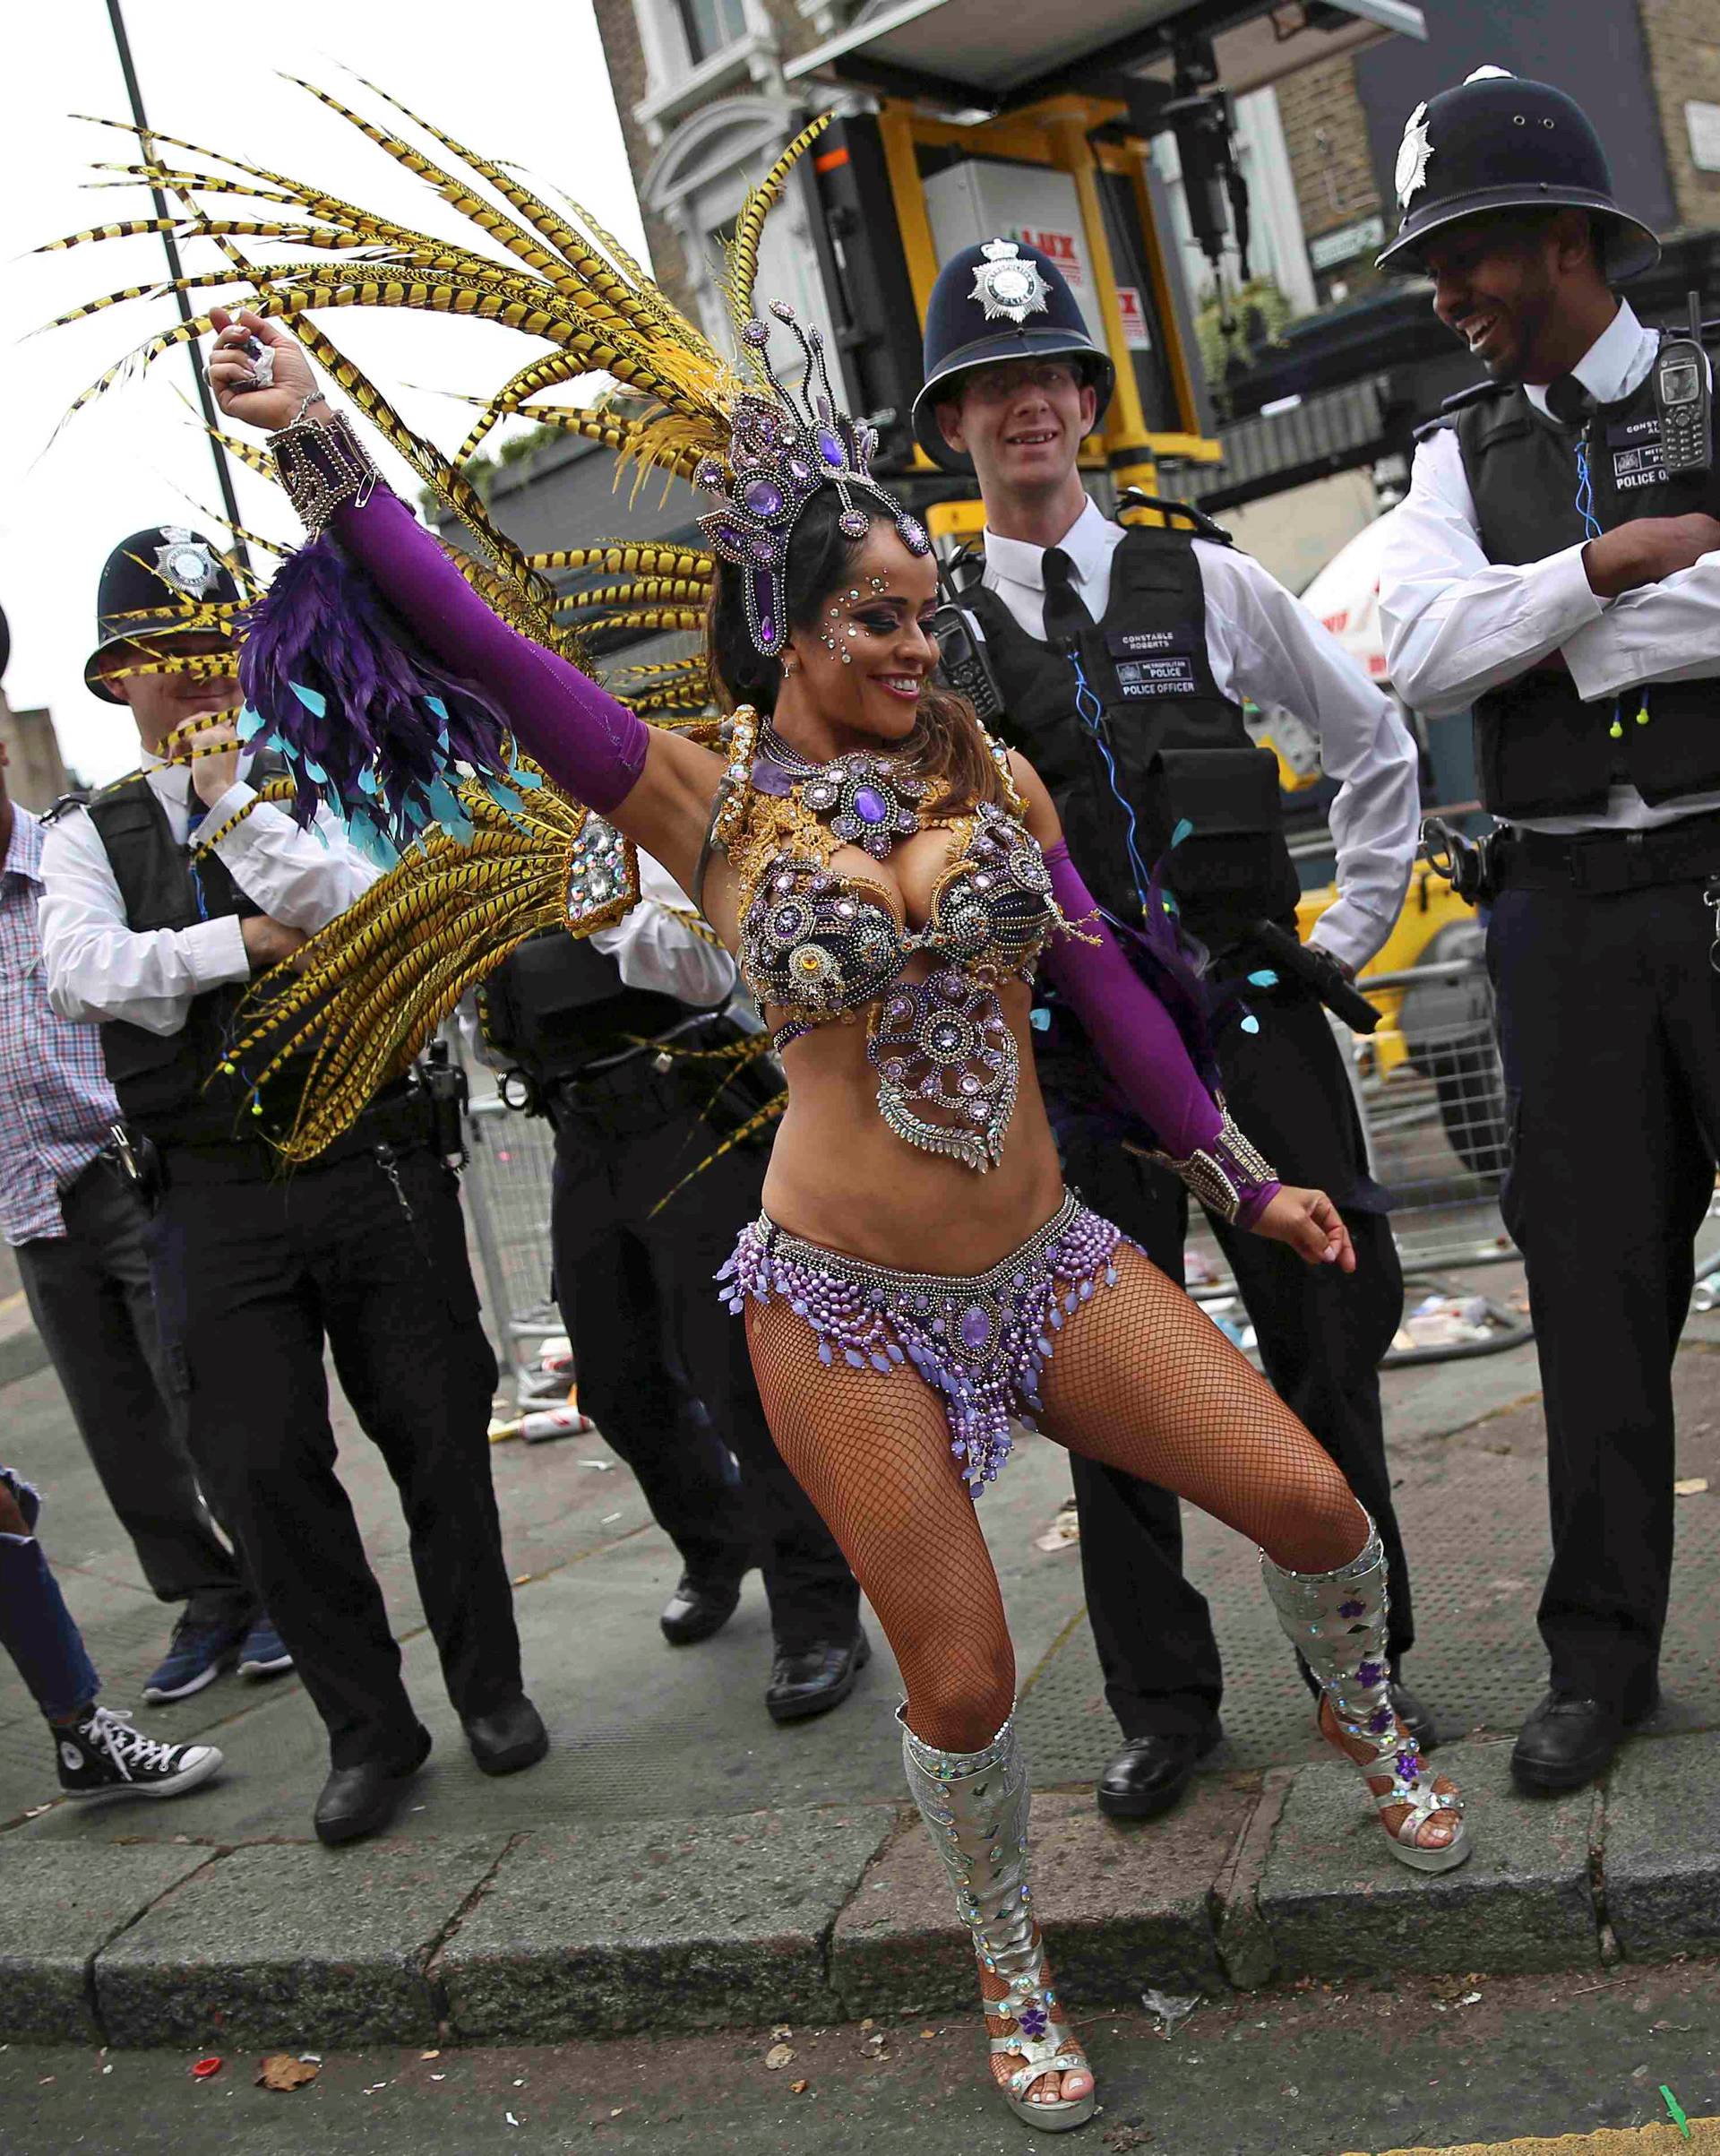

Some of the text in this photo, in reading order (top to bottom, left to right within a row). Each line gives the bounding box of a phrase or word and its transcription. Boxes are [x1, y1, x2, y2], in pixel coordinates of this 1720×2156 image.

[1626, 420, 1658, 434] CONST
[1616, 470, 1656, 489] POLICE
[1122, 632, 1173, 643] CONSTABLE
[1150, 668, 1181, 677] POLICE
[1122, 683, 1194, 695] POLICE OFFICER
